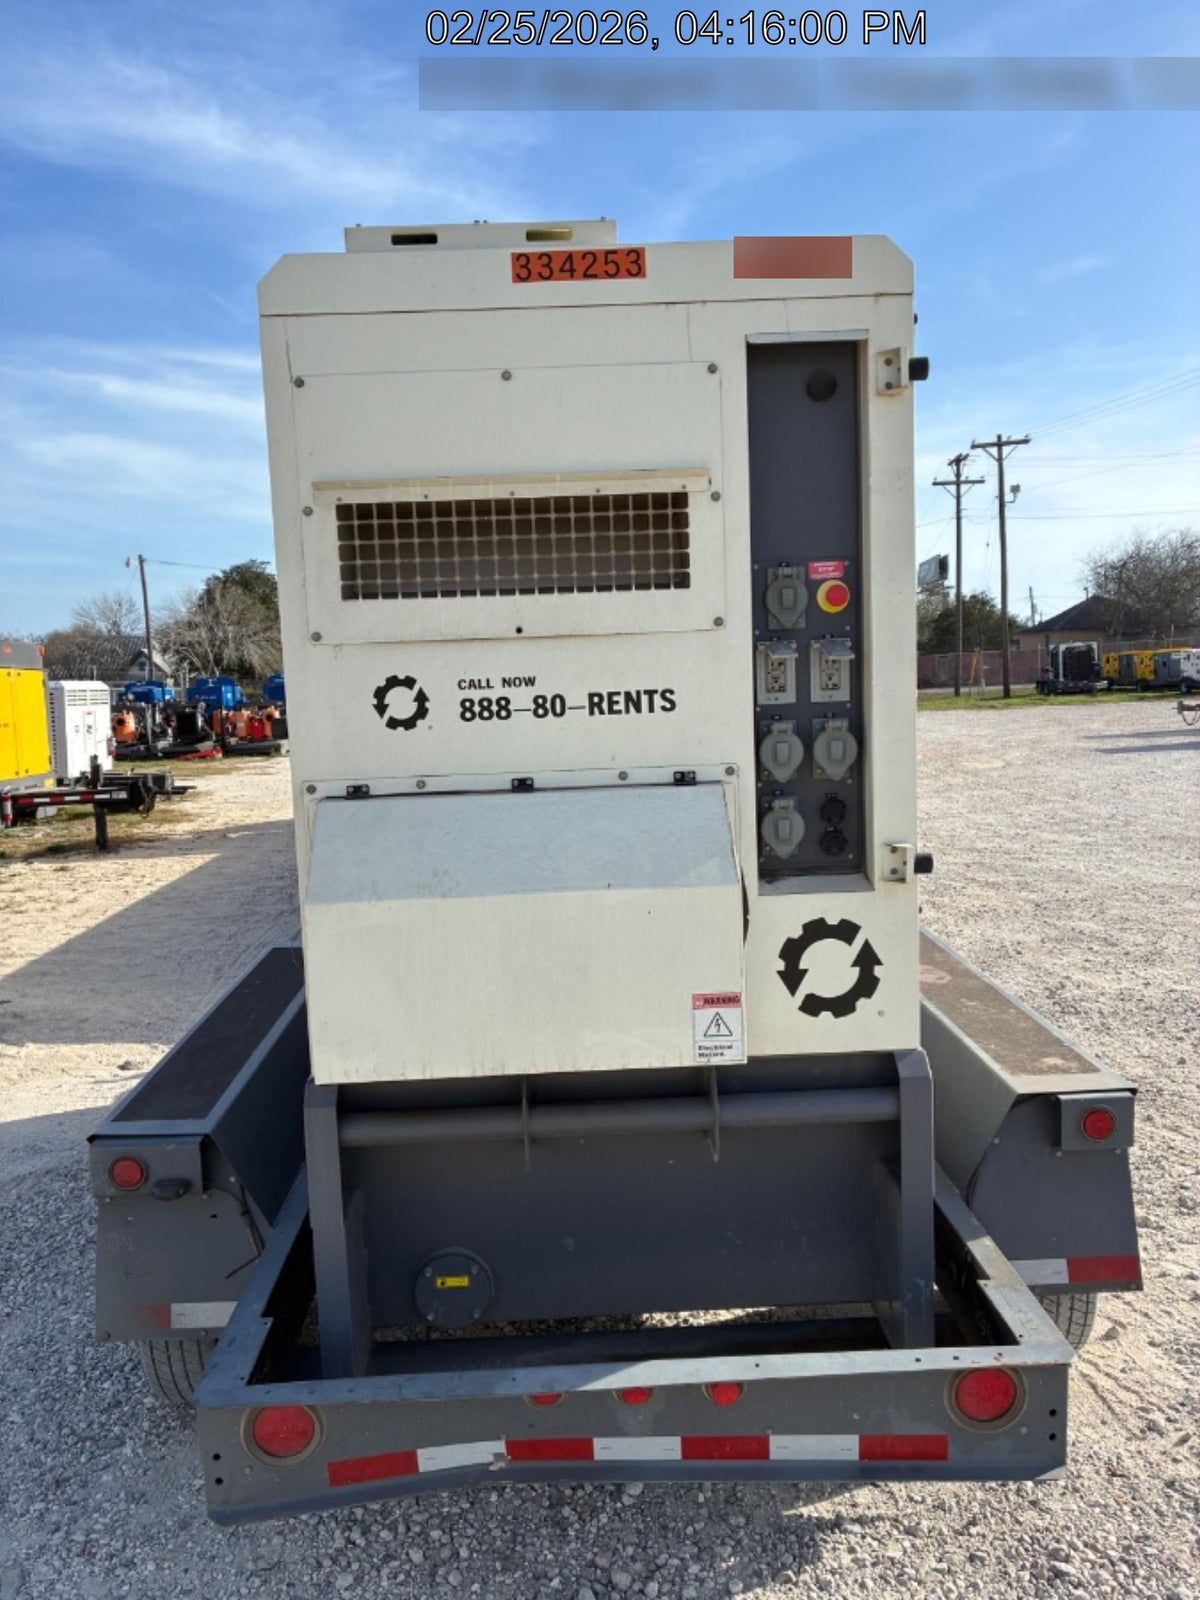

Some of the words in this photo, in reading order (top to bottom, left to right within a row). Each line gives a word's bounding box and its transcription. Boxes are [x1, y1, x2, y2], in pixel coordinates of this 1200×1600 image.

[515, 249, 643, 283] 334253
[457, 677, 495, 691] CALL
[501, 675, 537, 689] NOW
